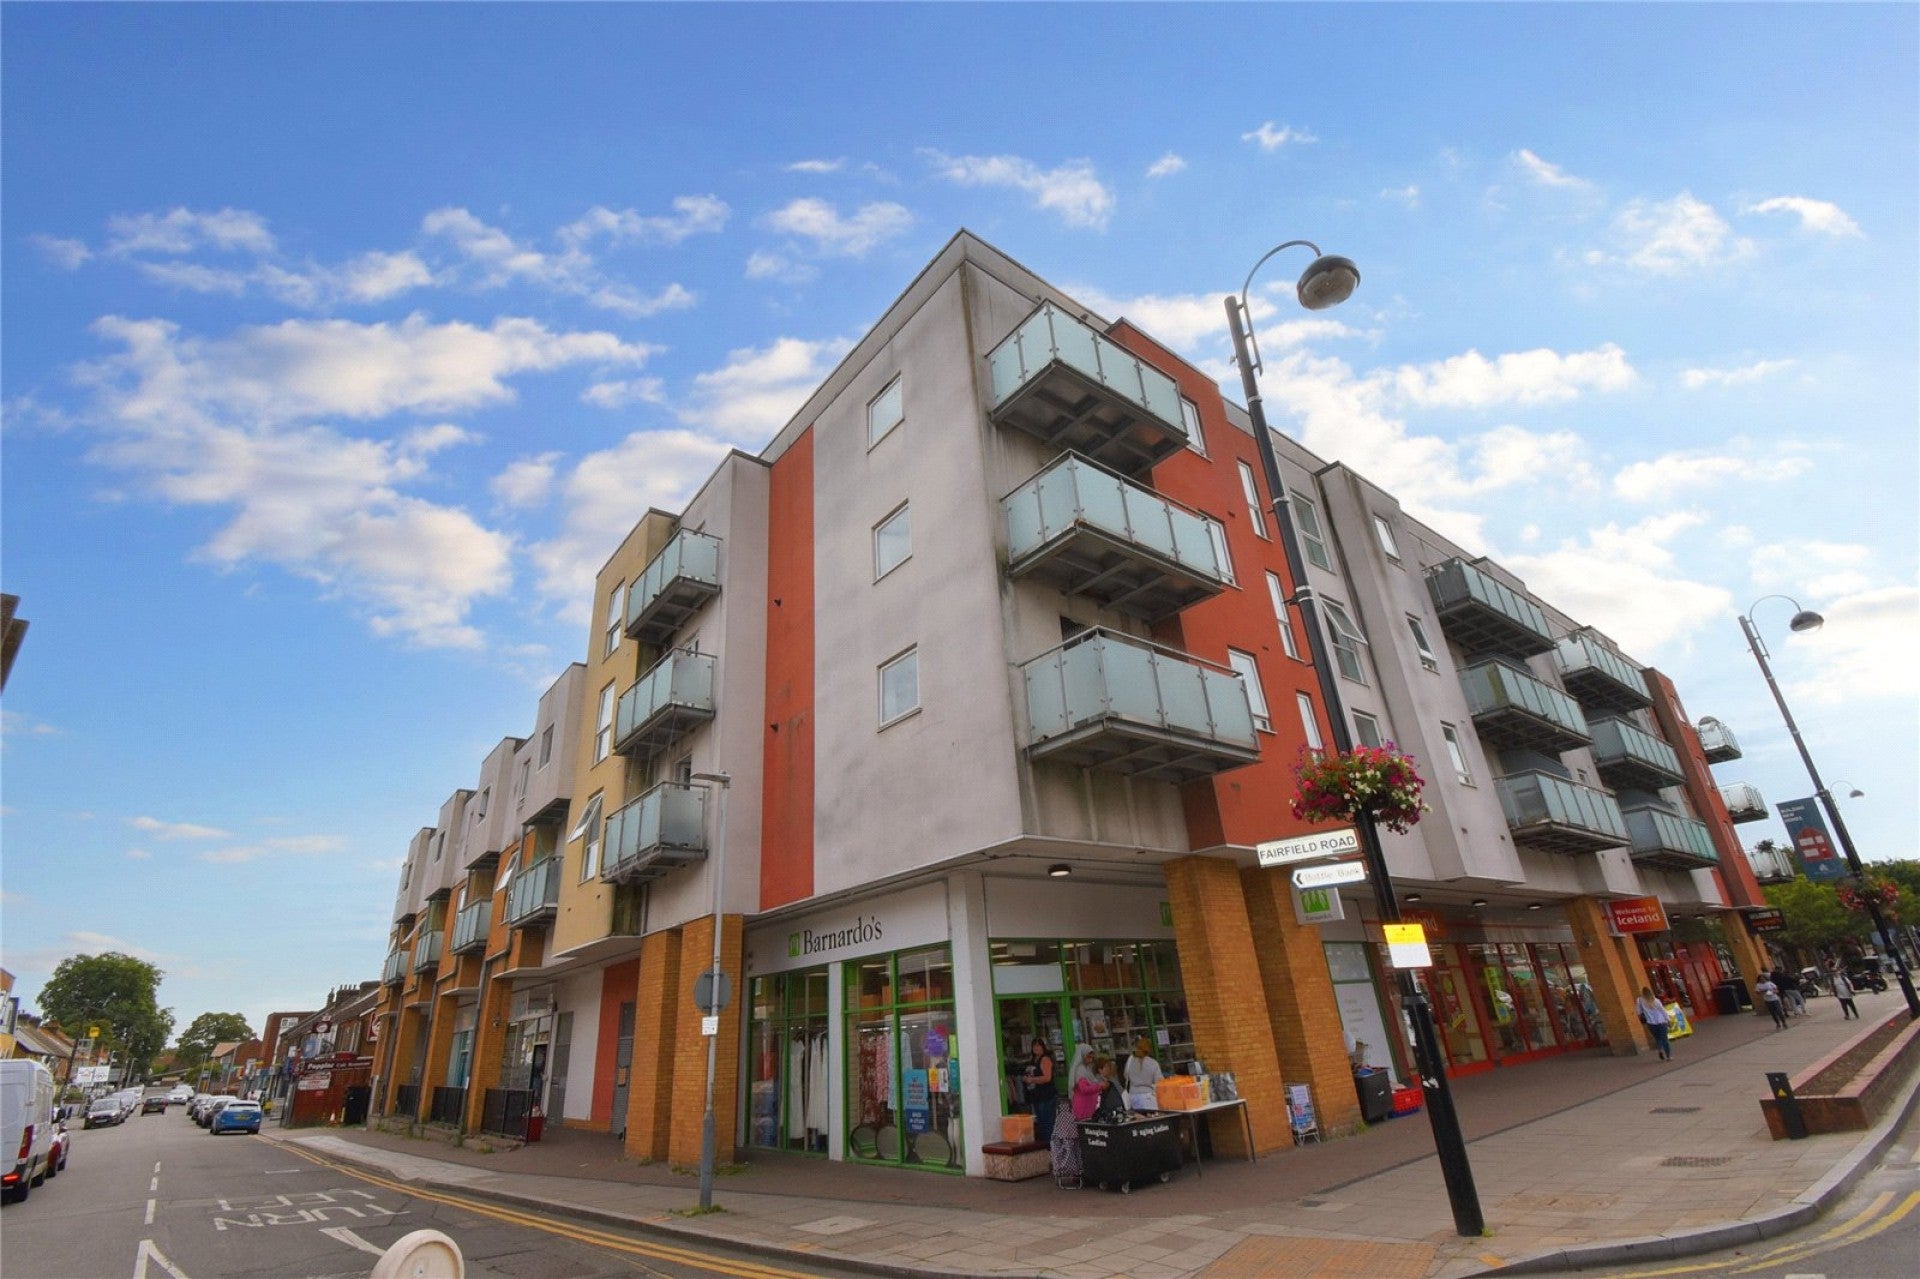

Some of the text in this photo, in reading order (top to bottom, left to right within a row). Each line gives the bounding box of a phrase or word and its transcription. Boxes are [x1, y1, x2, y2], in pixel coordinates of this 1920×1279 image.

[1260, 835, 1355, 860] FAIRFIELD ROAD
[1616, 912, 1661, 926] Iceland
[803, 915, 883, 955] Barnardo's
[211, 1188, 377, 1212] LEFT
[213, 1203, 411, 1231] TURN
